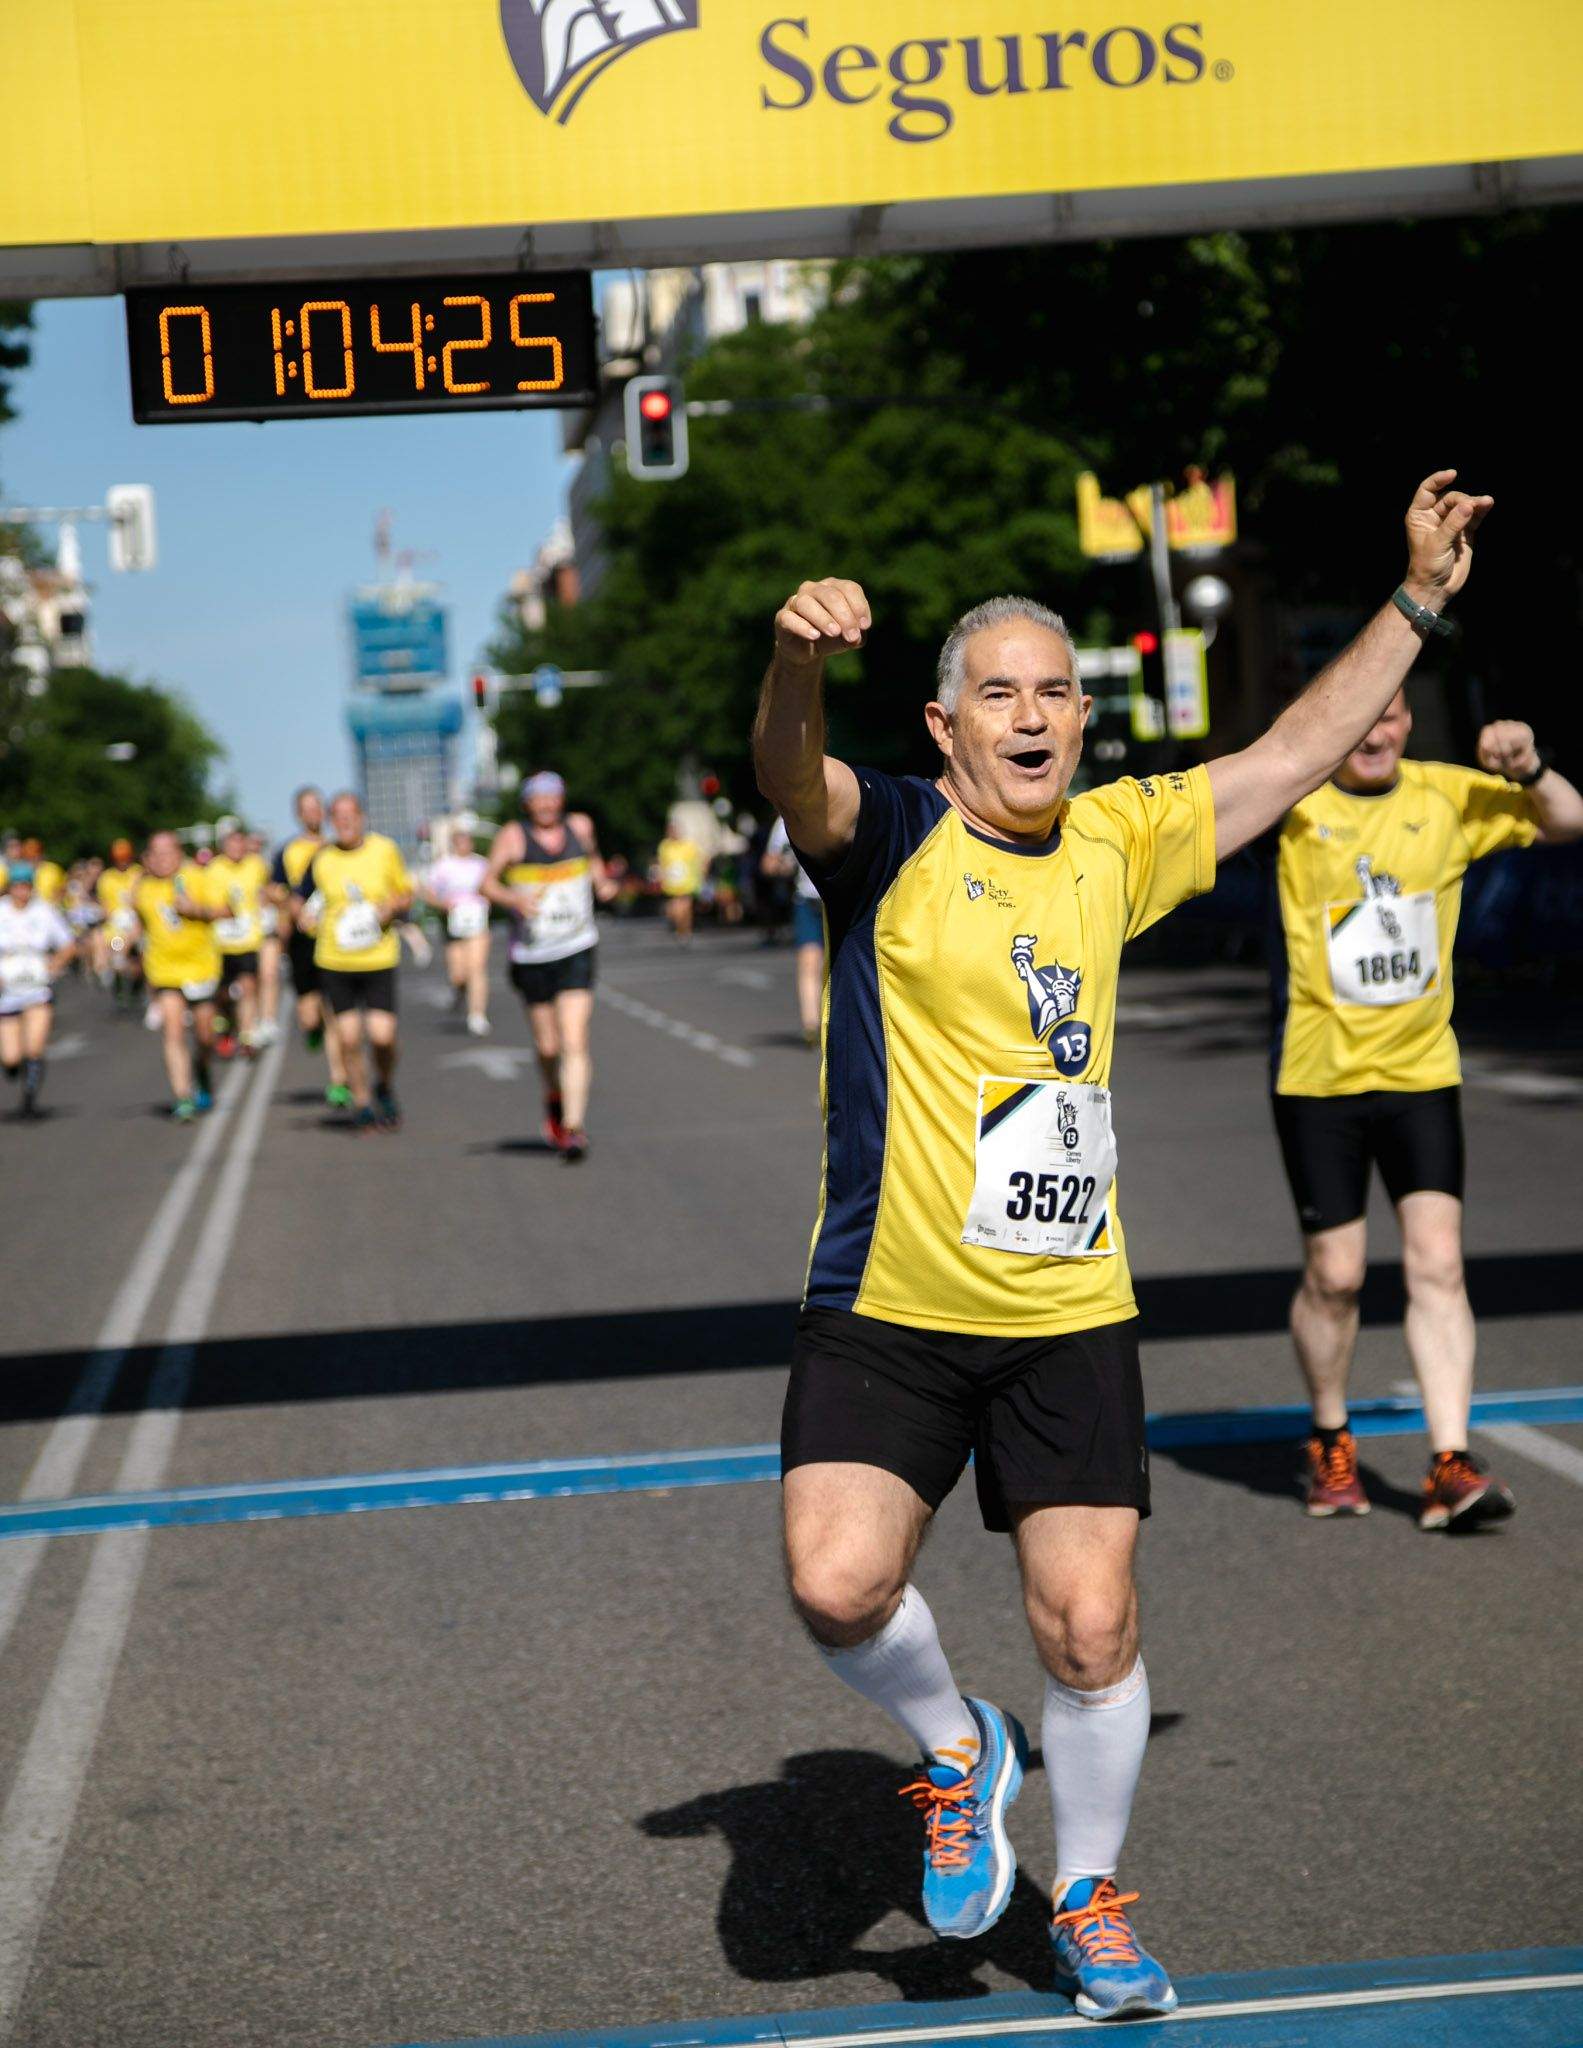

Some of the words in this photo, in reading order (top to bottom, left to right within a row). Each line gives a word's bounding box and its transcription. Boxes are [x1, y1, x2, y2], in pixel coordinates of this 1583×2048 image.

[1356, 950, 1419, 984] 1864
[1057, 1033, 1088, 1062] 13
[1065, 1132, 1077, 1145] 13
[1006, 1171, 1096, 1224] 3522
